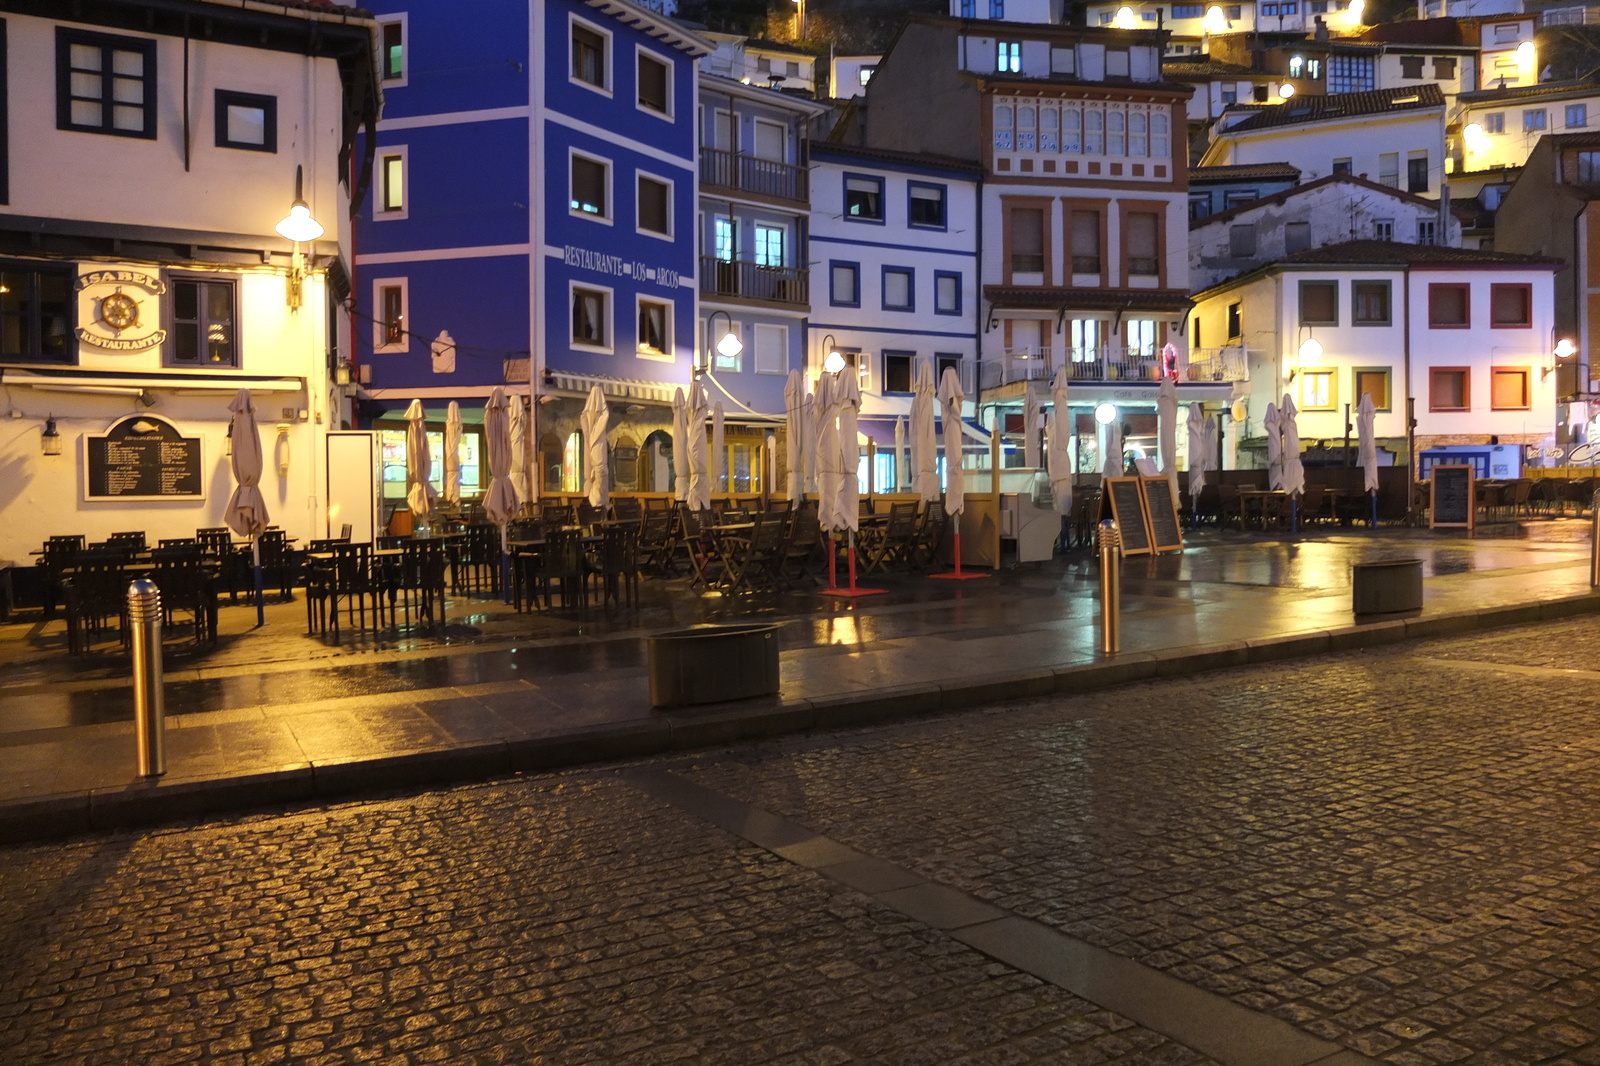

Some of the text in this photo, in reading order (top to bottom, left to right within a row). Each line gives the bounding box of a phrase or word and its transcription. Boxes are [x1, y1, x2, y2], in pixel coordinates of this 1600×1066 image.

[564, 245, 679, 289] RESTAURANTE LOS ARCOS
[80, 271, 159, 290] ISABEL
[80, 330, 161, 350] RESTAURANTE
